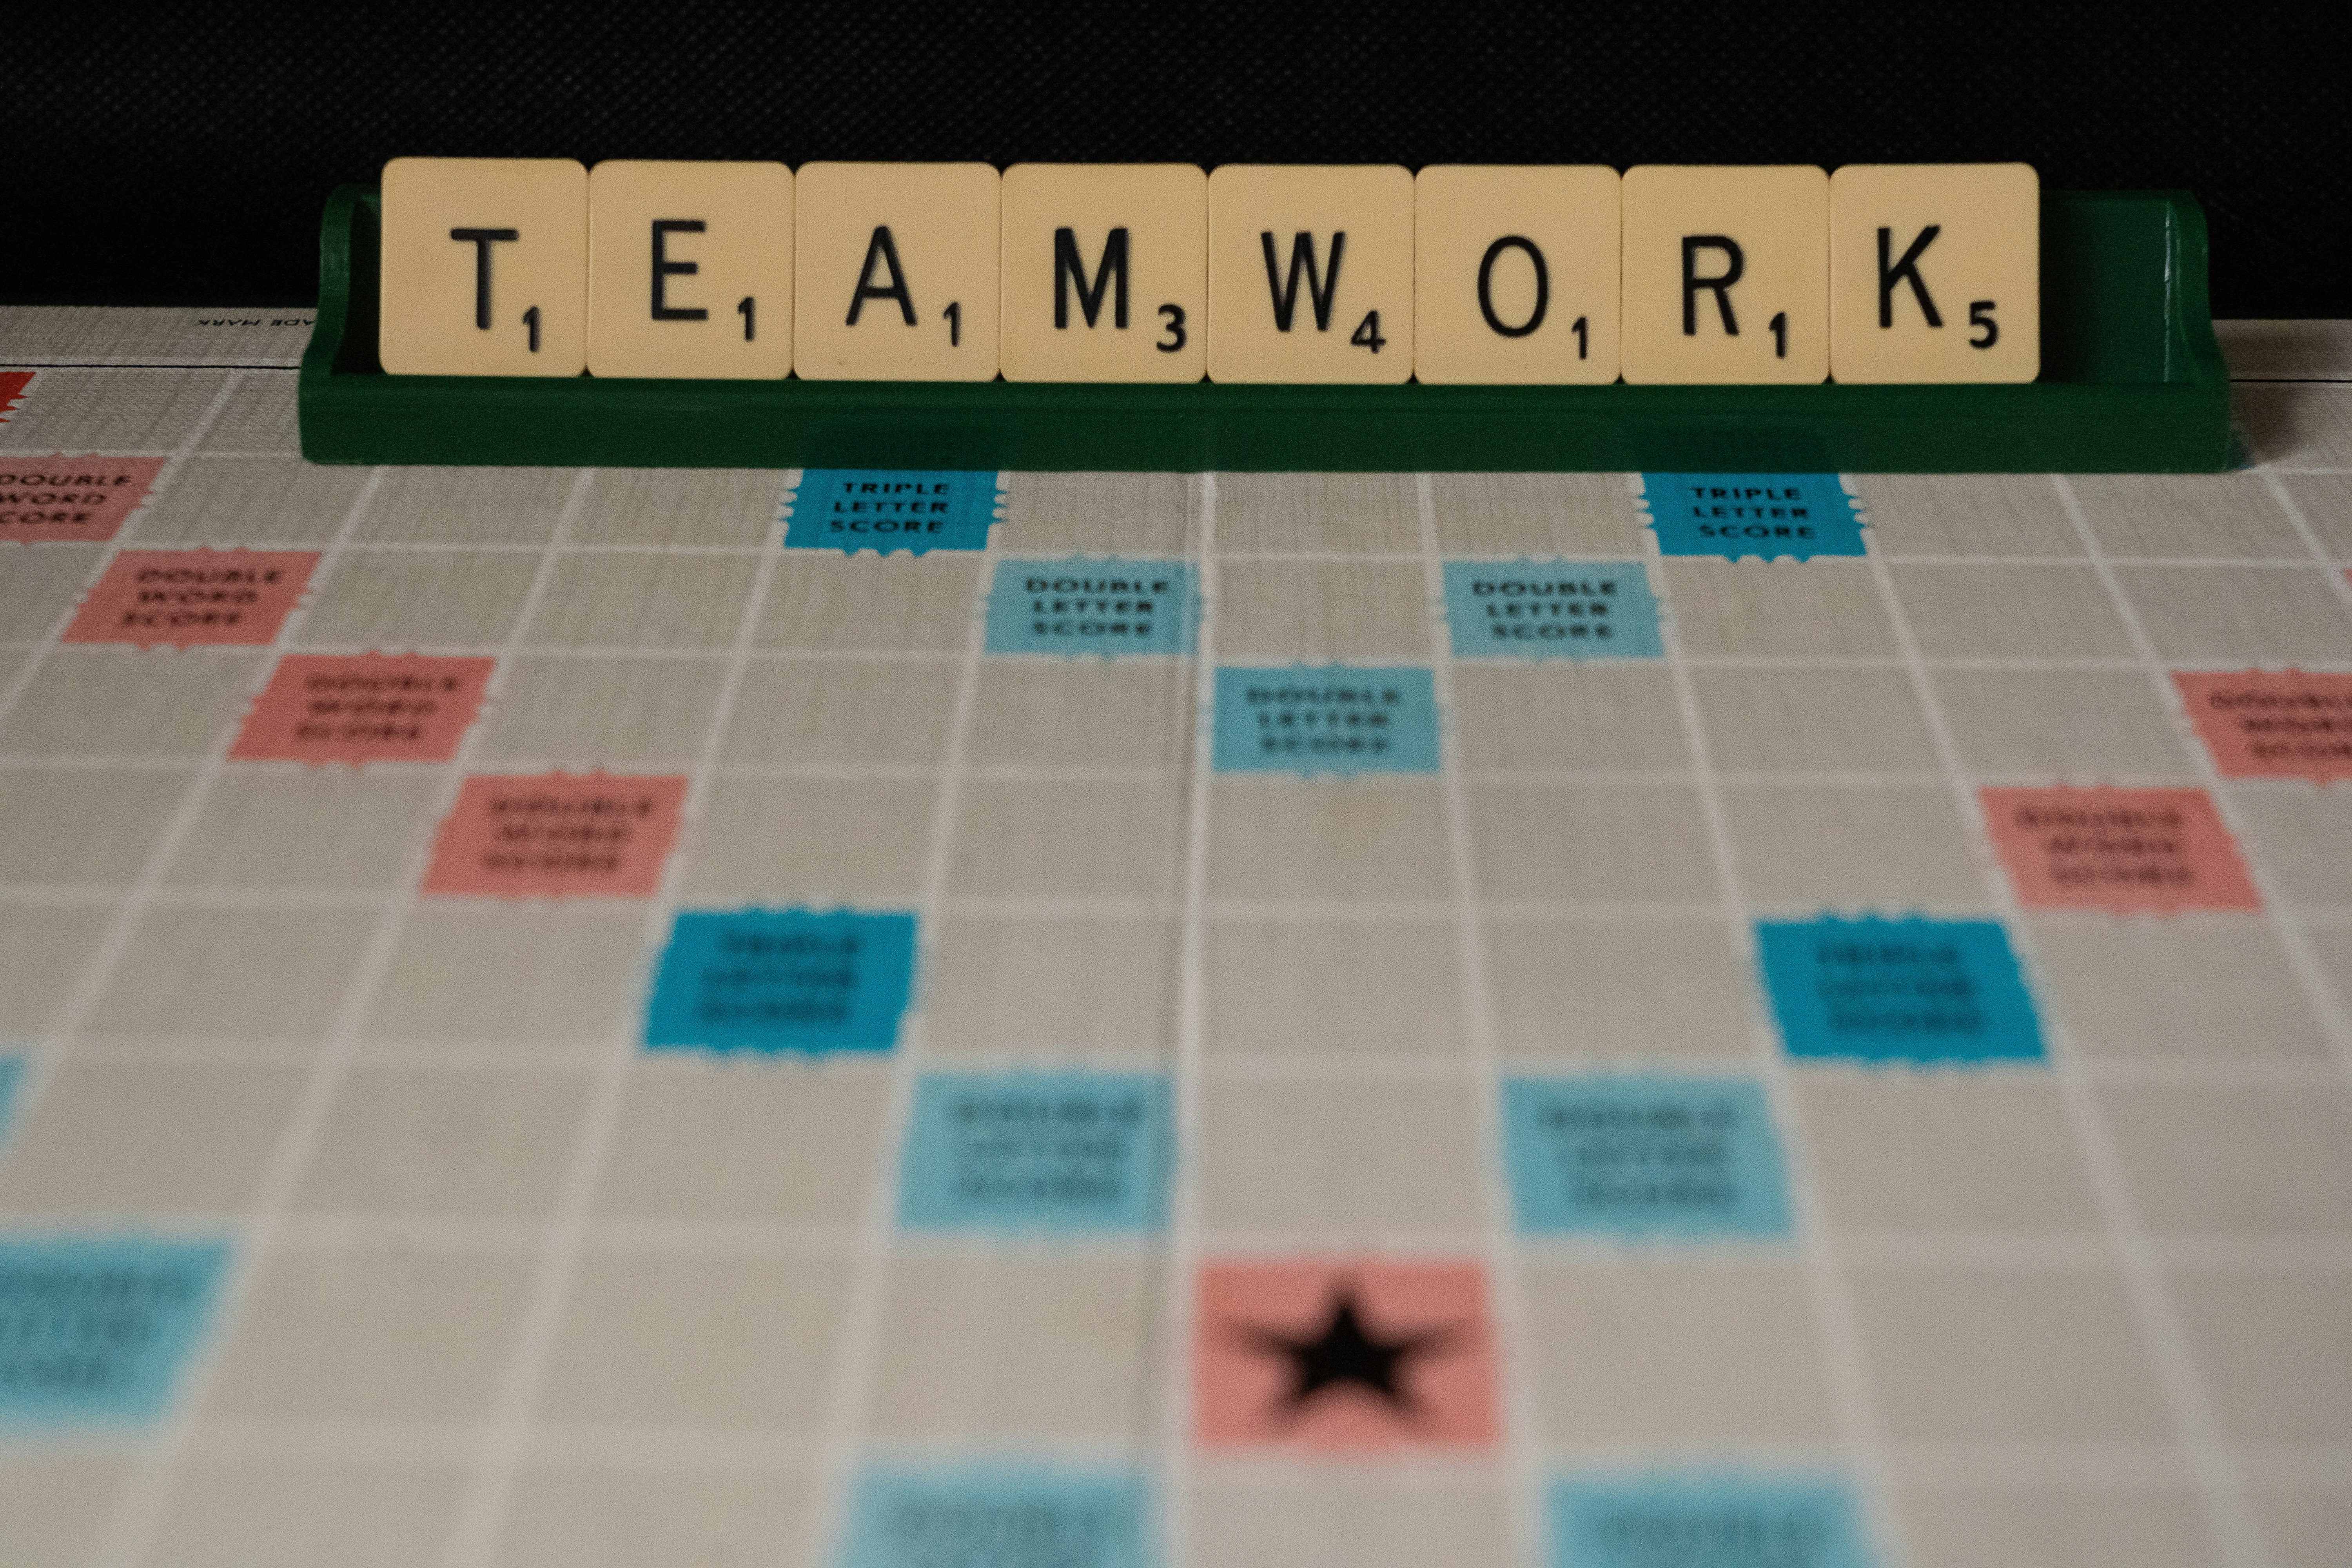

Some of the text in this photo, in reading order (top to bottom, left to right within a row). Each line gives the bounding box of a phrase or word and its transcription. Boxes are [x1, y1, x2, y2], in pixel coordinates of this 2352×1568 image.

[738, 296, 756, 341] 1
[942, 301, 961, 347] 1
[1969, 300, 1999, 349] 5
[522, 305, 541, 352] 1
[1156, 303, 1187, 352] 3
[1350, 310, 1387, 354] 4
[1768, 311, 1786, 359] 1
[1571, 315, 1588, 360] 1
[843, 482, 949, 494] TRIPLE
[1691, 487, 1800, 500] TRIPLE
[834, 501, 949, 513] LETTER
[1693, 507, 1810, 519] LETTER
[828, 520, 944, 534] SCORE
[1699, 526, 1817, 538] SCORE
[1026, 580, 1168, 593] DOUBLE
[1472, 581, 1617, 596] DOUBLE
[1033, 600, 1154, 613] LETTER
[1487, 603, 1608, 617] LETTER
[1033, 621, 1151, 636] SCORE
[1492, 624, 1612, 640] SCORE
